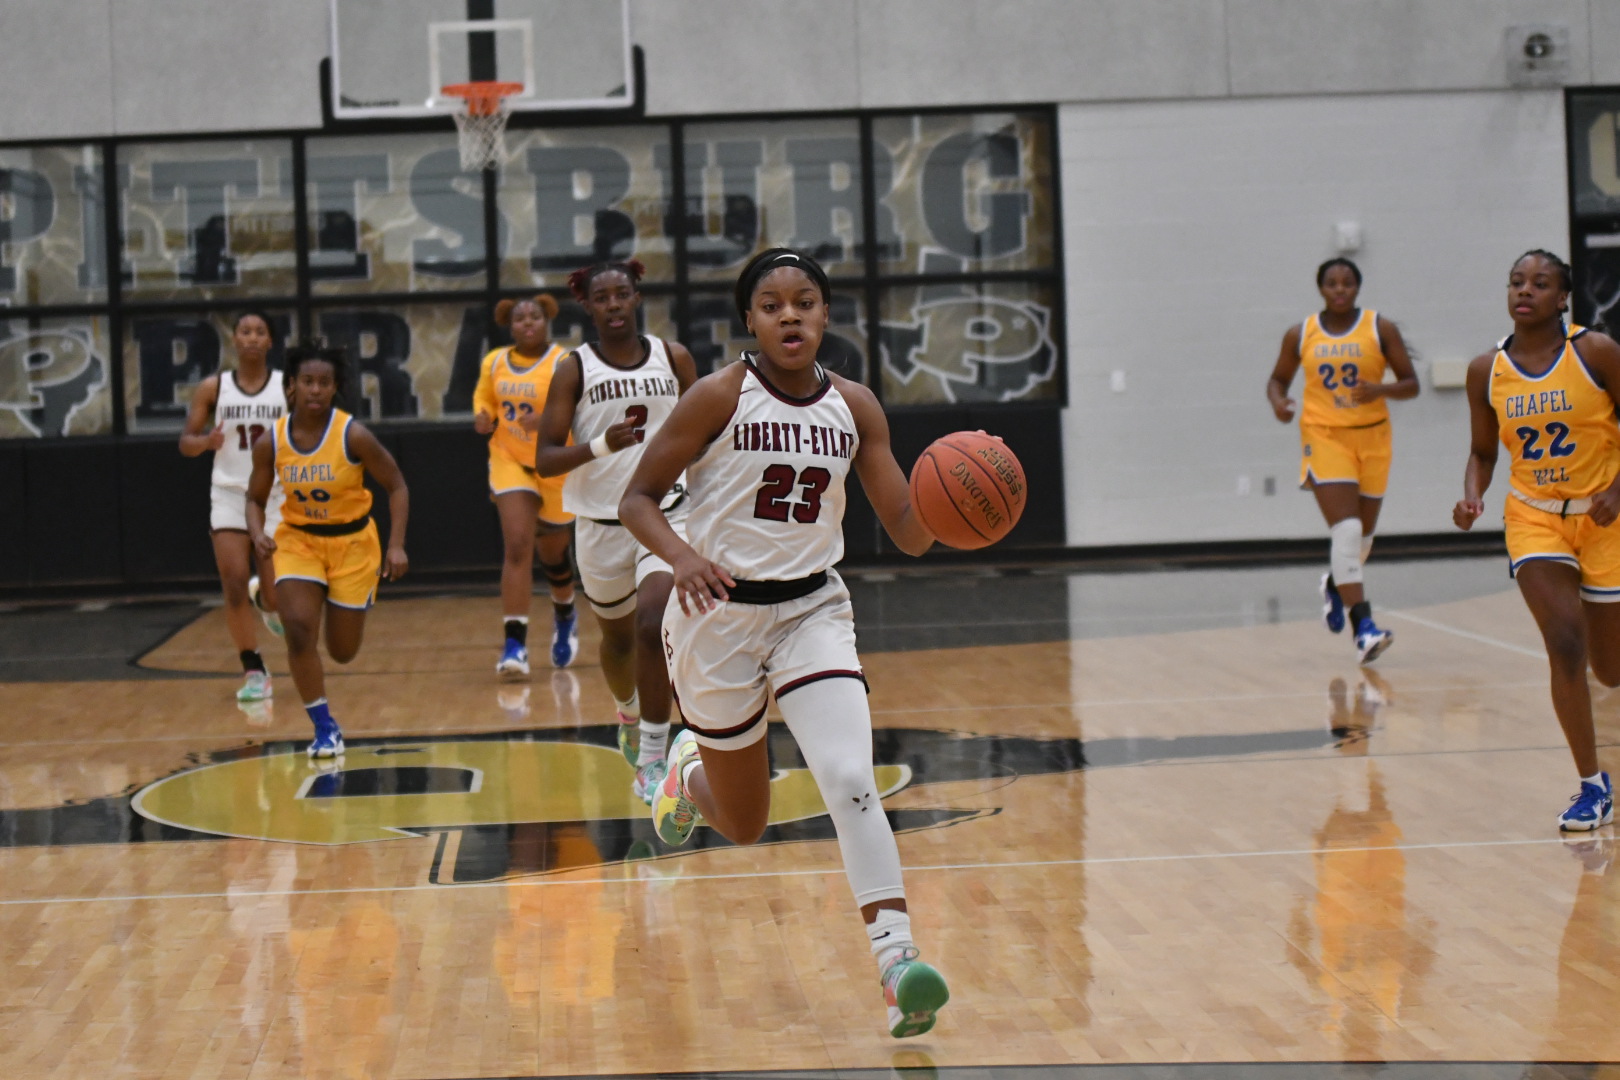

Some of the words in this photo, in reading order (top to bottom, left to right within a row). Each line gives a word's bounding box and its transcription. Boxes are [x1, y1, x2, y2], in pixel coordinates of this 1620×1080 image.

[1318, 362, 1359, 390] 23
[1506, 389, 1573, 418] CHAPEL
[624, 404, 649, 443] 2
[1516, 421, 1576, 461] 22
[284, 464, 335, 482] CHAPEL
[753, 463, 832, 524] 23
[949, 461, 1005, 530] SPALDING
